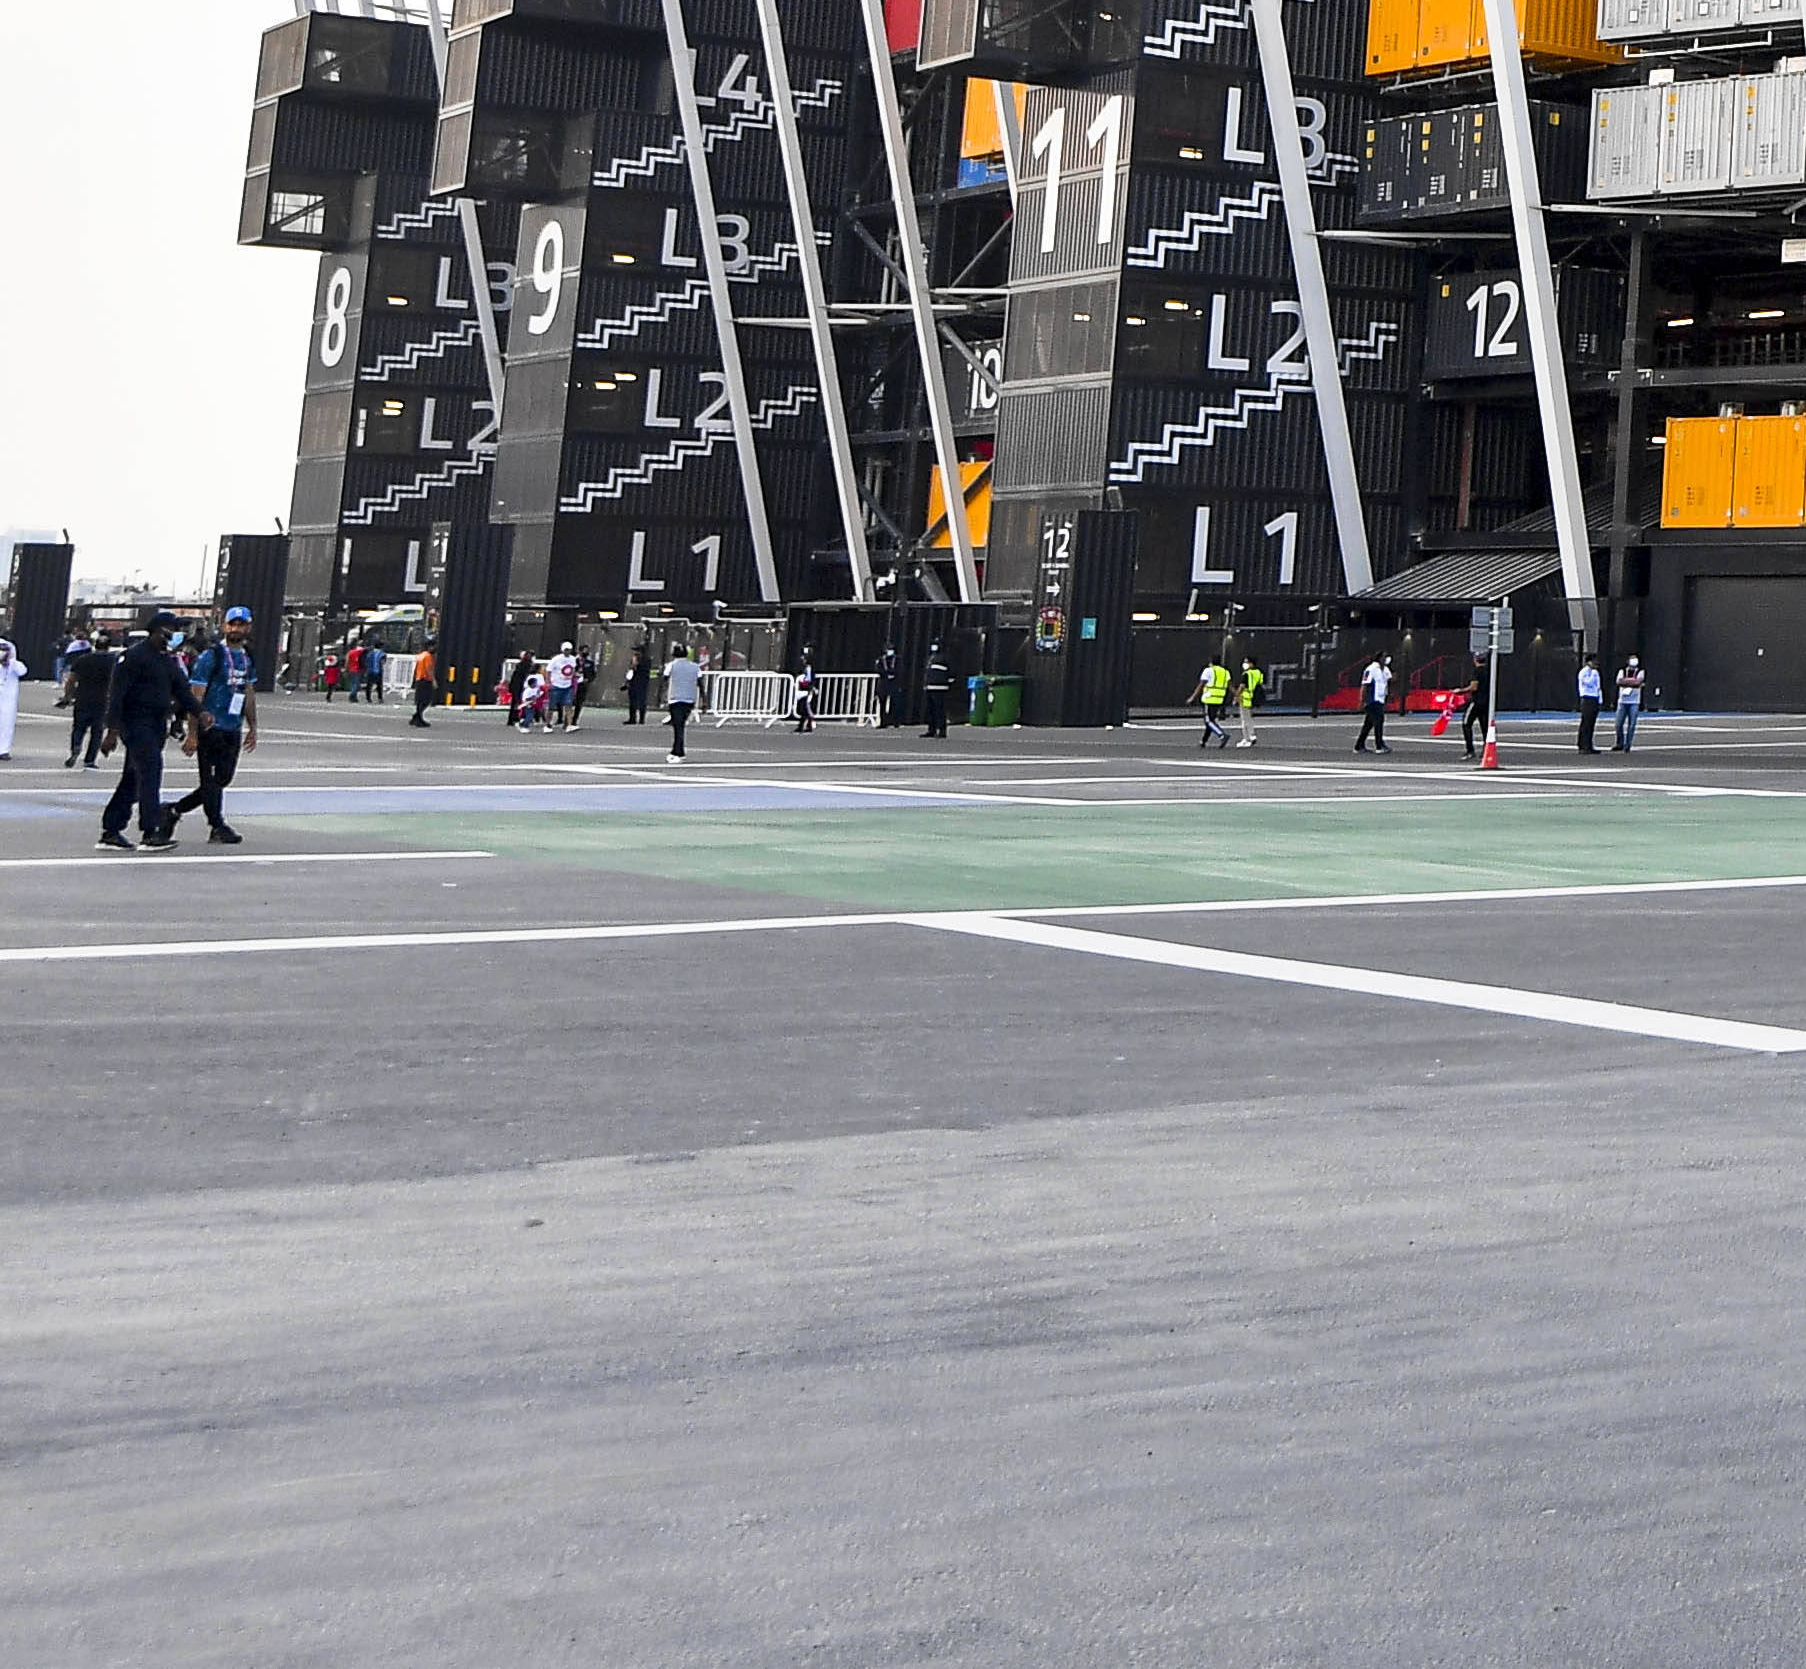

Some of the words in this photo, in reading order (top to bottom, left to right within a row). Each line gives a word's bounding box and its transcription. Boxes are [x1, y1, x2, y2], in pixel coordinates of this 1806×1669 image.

[1223, 86, 1327, 170] L3
[1032, 95, 1122, 253] 11
[528, 220, 564, 336] 9
[661, 207, 750, 274] L3
[321, 267, 351, 367] 8
[1207, 294, 1309, 375] L2
[1466, 281, 1520, 358] 12
[420, 398, 500, 450] L2
[645, 369, 732, 430] L2
[628, 531, 721, 591] L1
[1043, 528, 1070, 559] 12
[1191, 506, 1298, 585] L1
